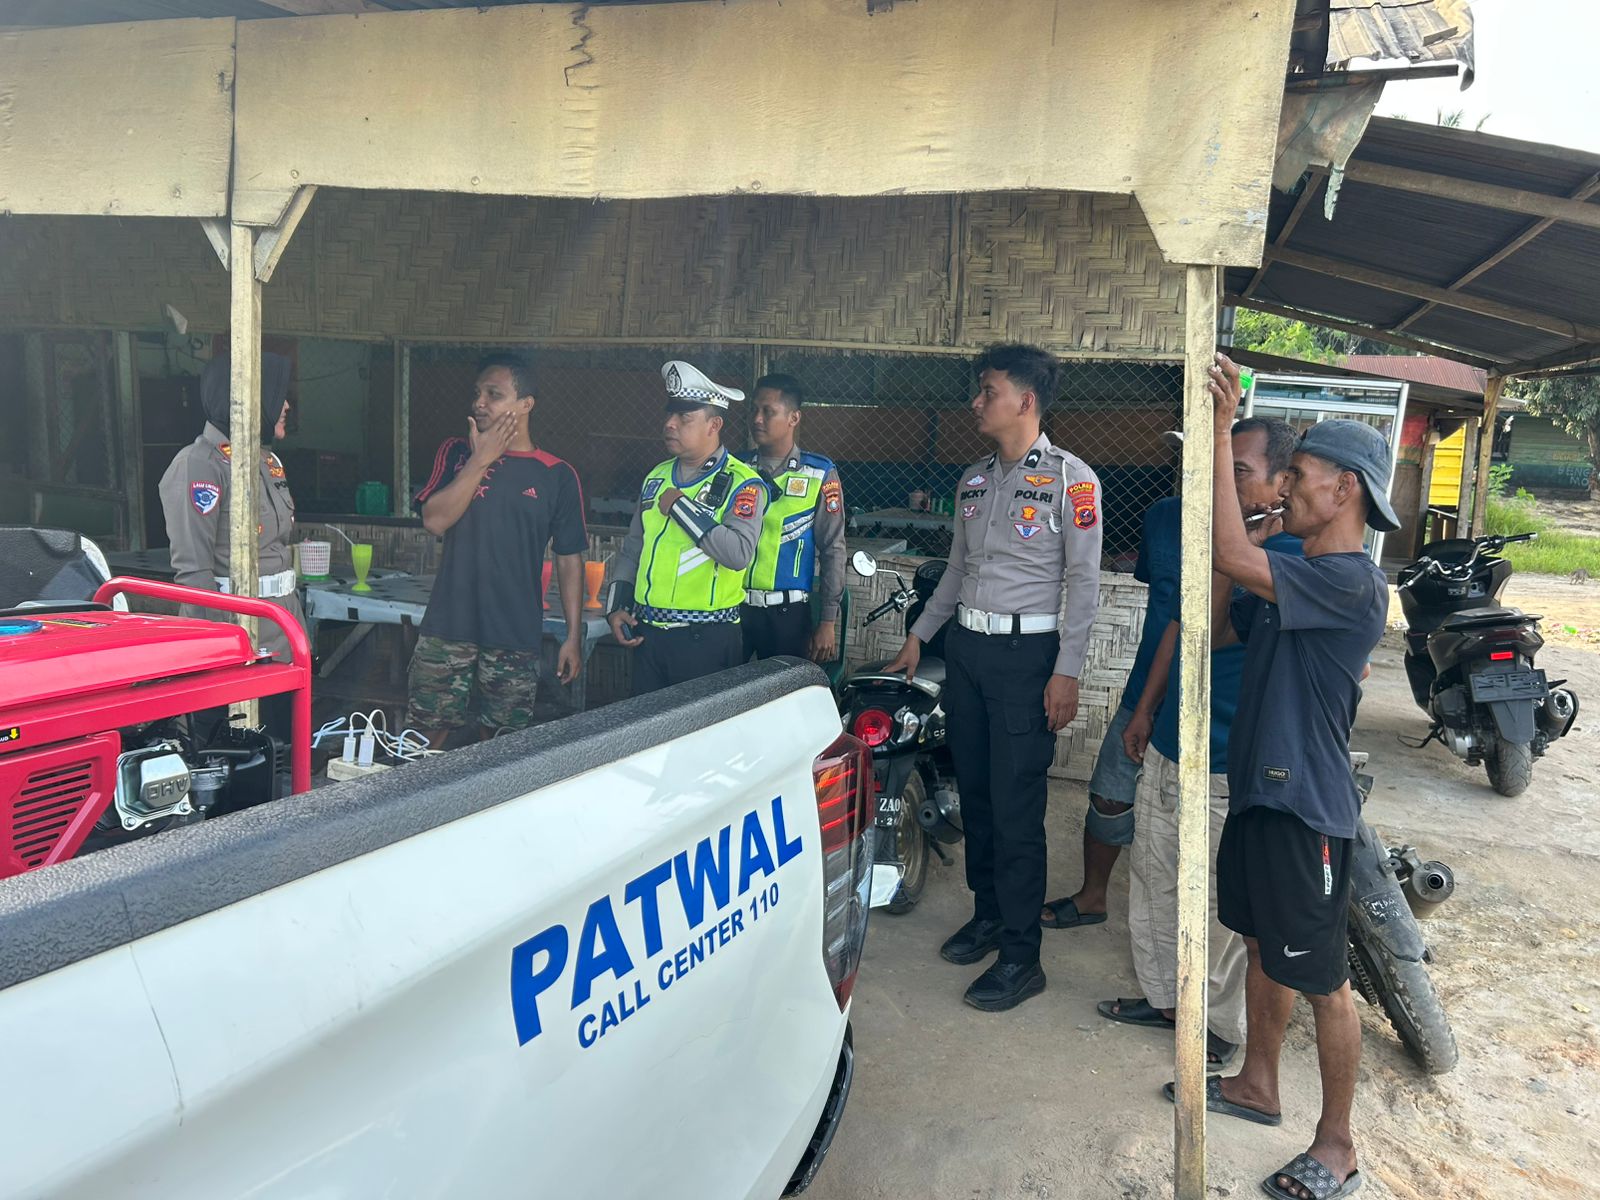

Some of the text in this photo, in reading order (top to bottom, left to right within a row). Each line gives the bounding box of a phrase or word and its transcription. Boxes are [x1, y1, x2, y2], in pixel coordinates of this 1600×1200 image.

[1014, 490, 1053, 504] POLRI
[510, 795, 802, 1047] PATWAL
[578, 882, 779, 1049] CALL CENTER 110
